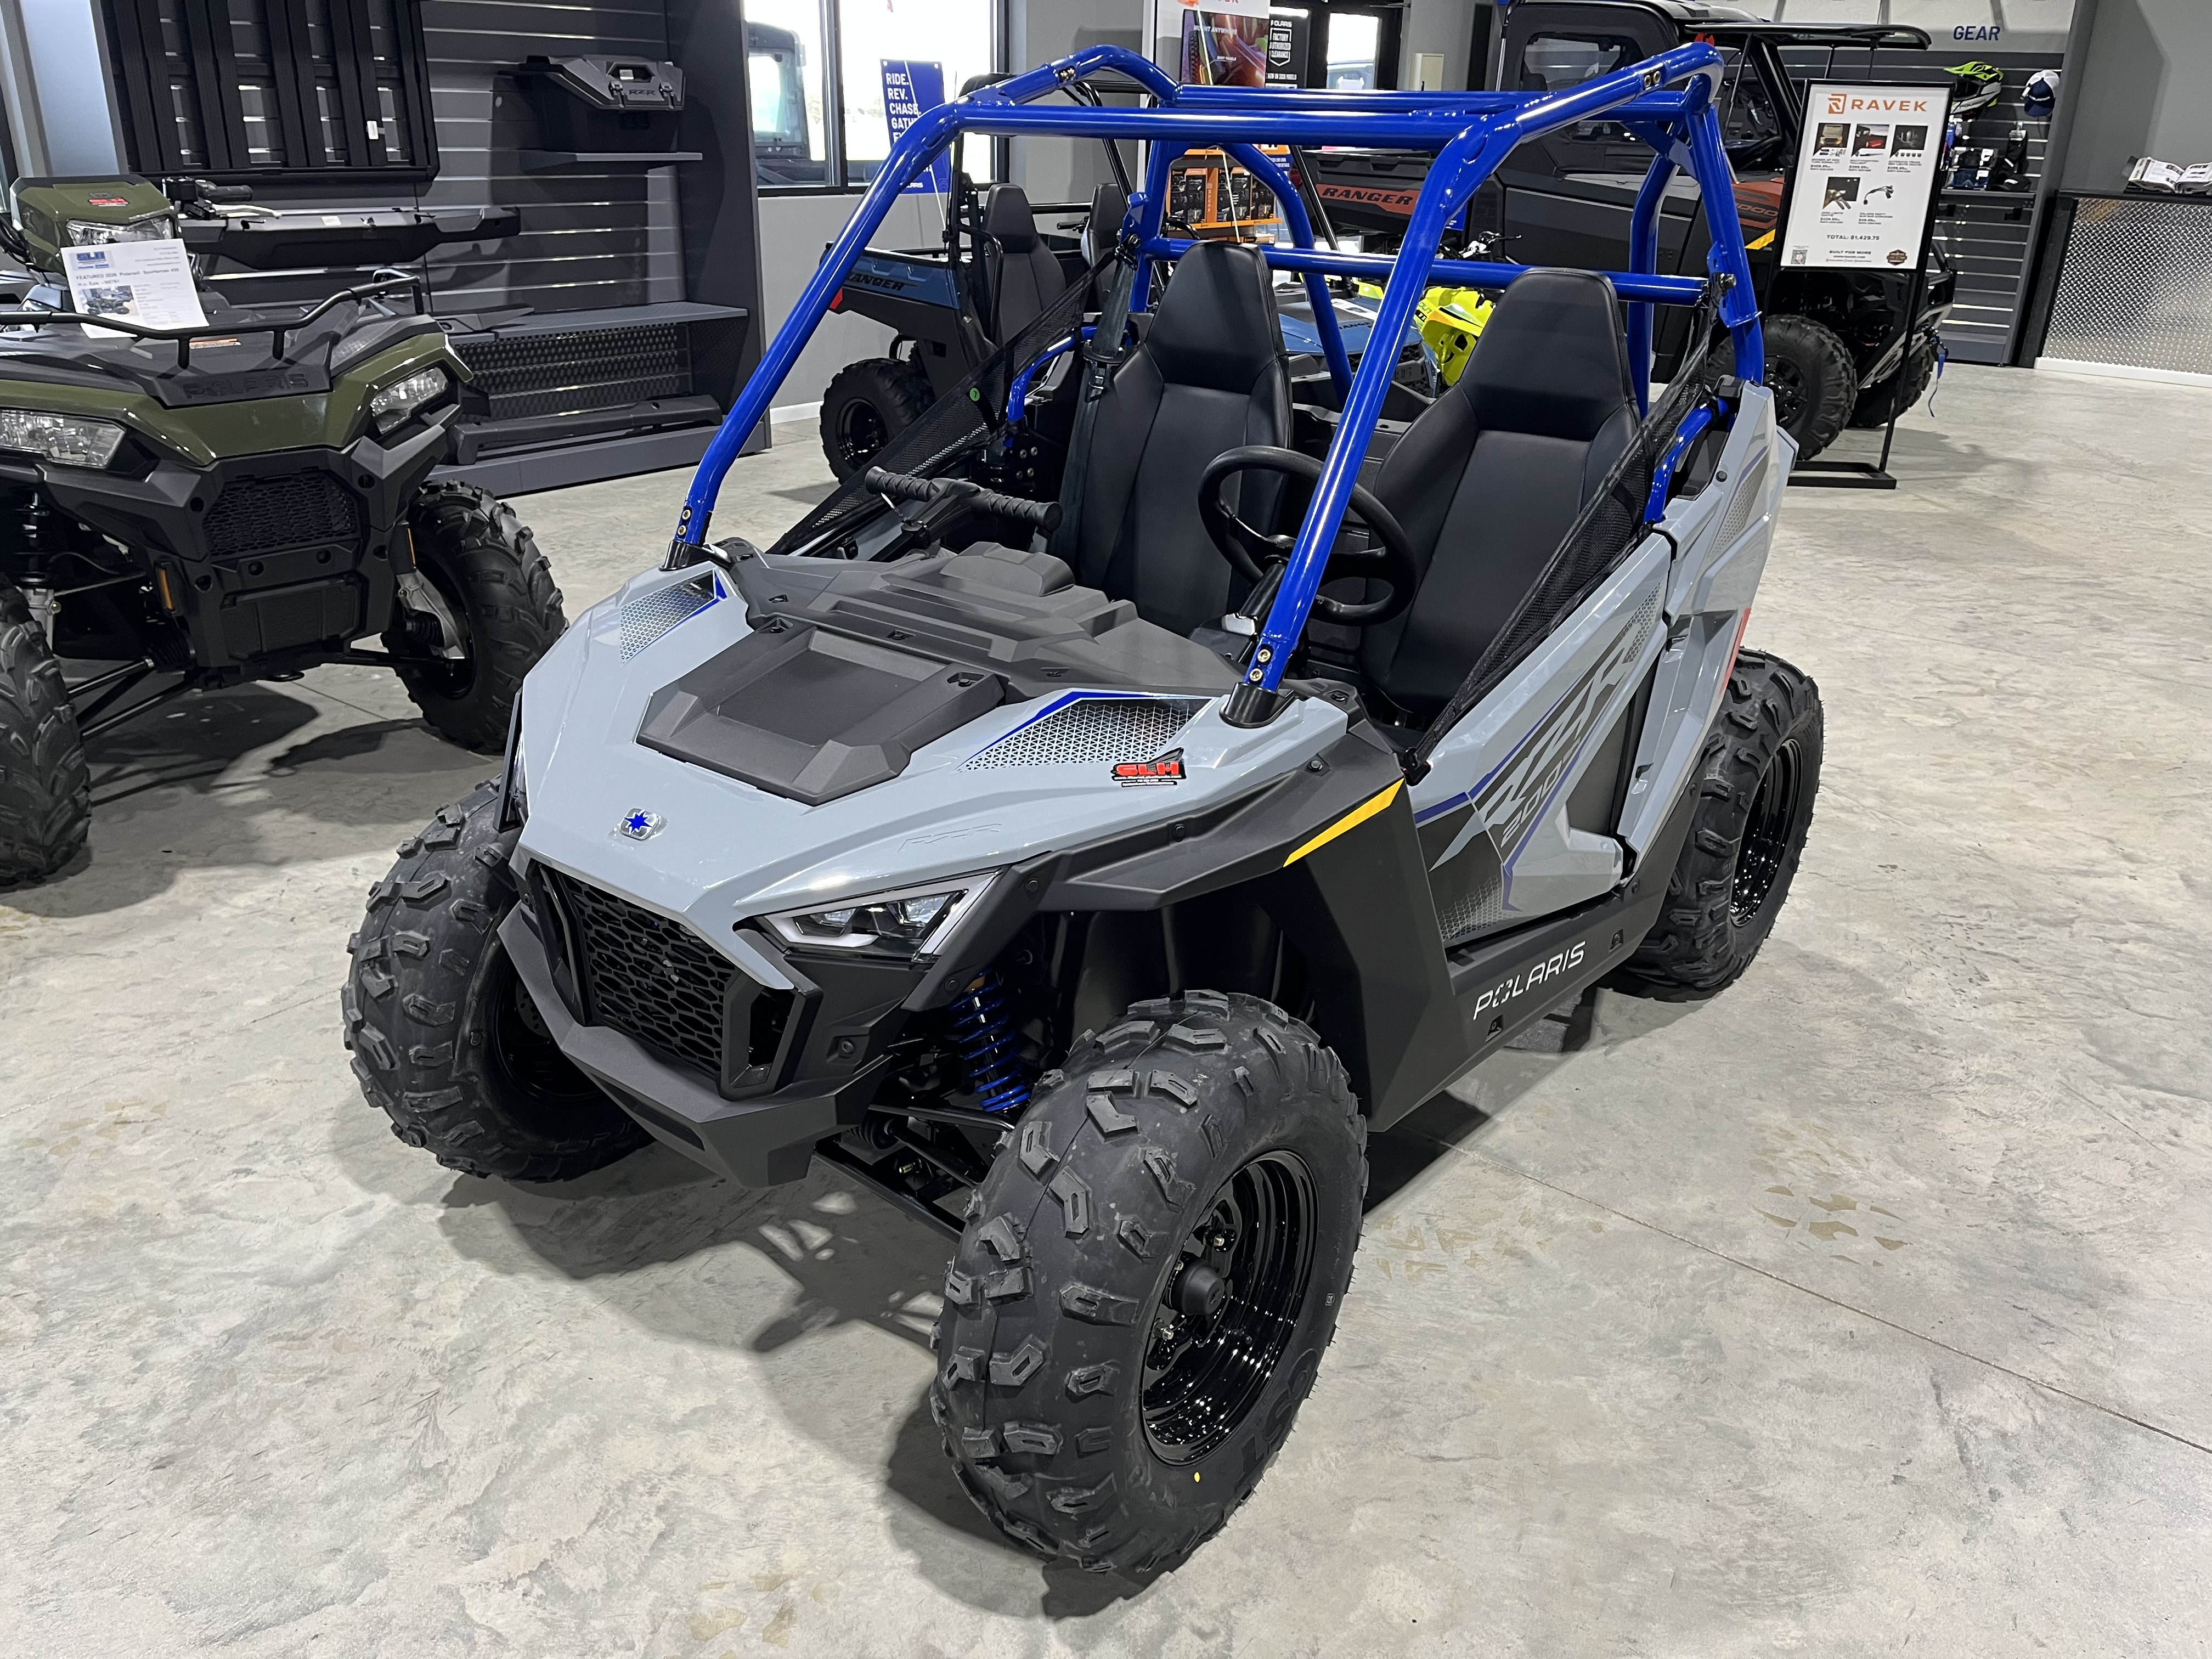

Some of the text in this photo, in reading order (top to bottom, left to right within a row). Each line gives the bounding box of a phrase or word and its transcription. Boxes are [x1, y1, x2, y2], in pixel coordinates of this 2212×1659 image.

[1953, 25, 2001, 41] GEAR
[885, 72, 910, 86] RIDE.
[887, 87, 909, 100] REV.
[889, 103, 922, 115] CHASE.
[1851, 99, 1928, 112] RAVEK
[1322, 188, 1413, 205] RANGER
[1736, 202, 1779, 217] 000
[848, 274, 905, 291] ANGER
[1116, 761, 1179, 776] SLH
[1500, 759, 1563, 848] 200
[1473, 940, 1586, 1020] POLARIS
